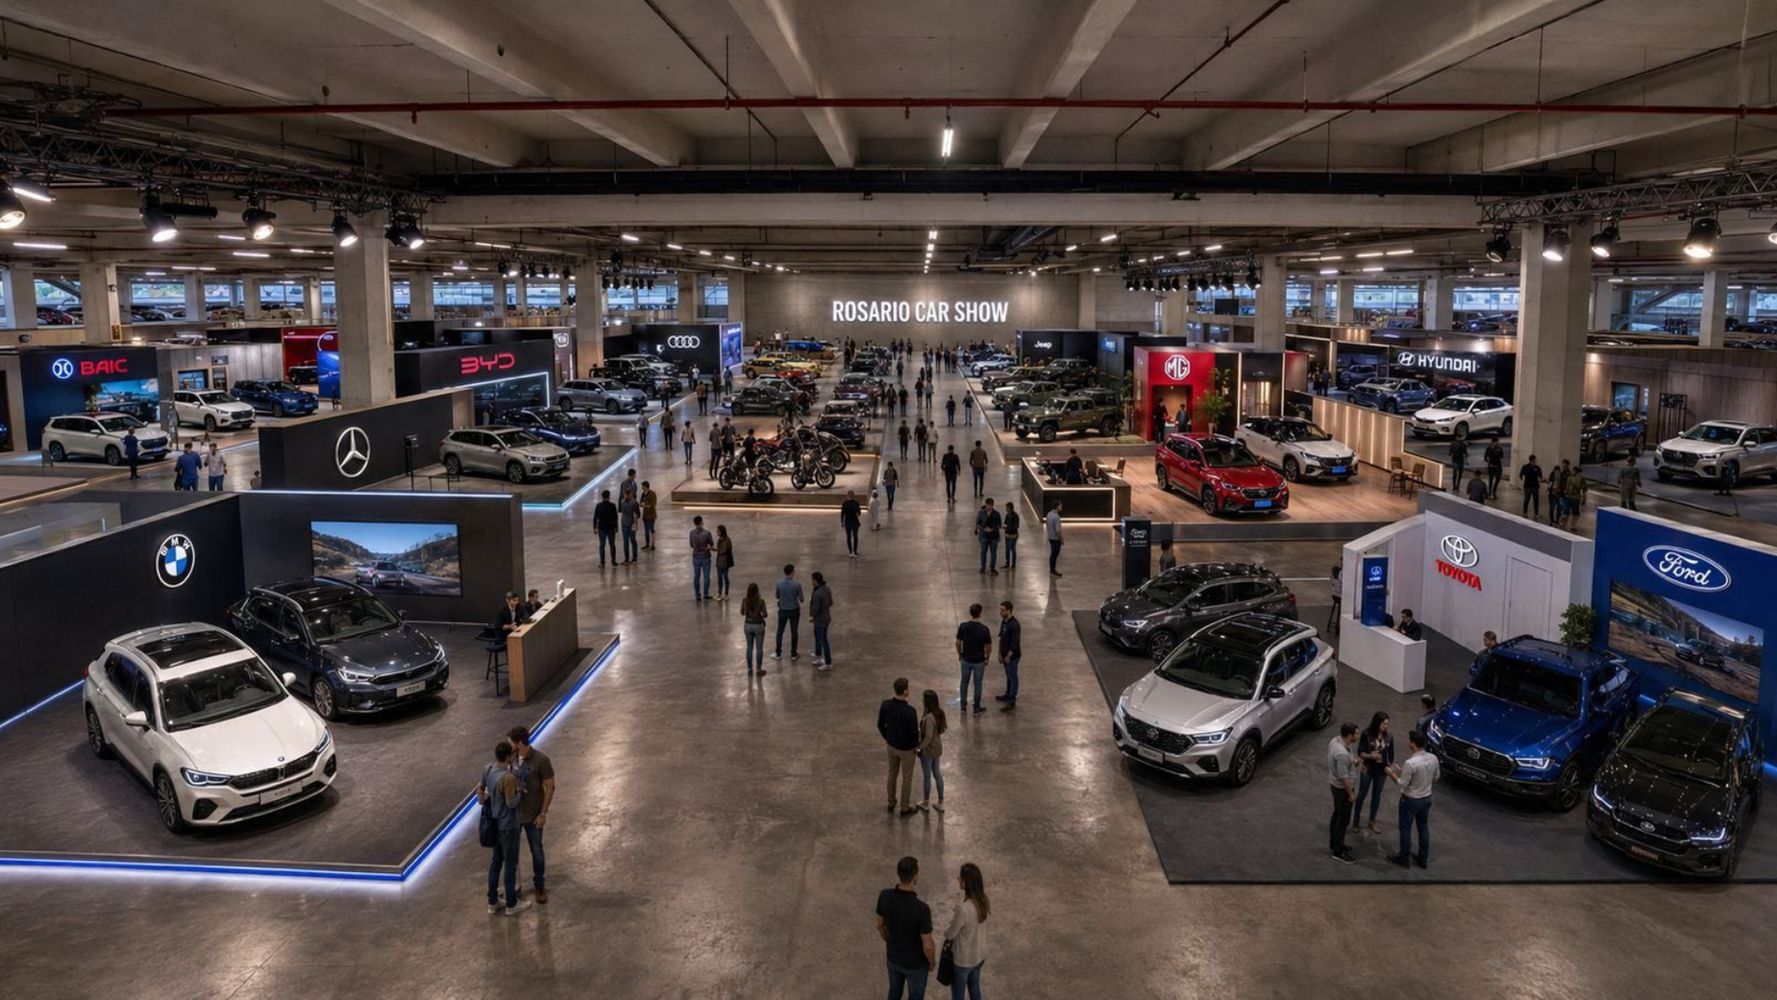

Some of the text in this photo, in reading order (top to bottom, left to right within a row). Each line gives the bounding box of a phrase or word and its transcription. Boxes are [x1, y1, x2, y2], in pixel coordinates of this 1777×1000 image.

[832, 300, 1009, 323] ROSARIO CAR SHOW
[1034, 340, 1052, 350] Jeep
[80, 359, 128, 375] BAIC
[460, 353, 515, 375] BYD
[1165, 355, 1190, 380] MG
[1417, 354, 1477, 374] HYUNDAI
[1435, 559, 1482, 592] TOYOTA
[1659, 551, 1712, 585] Ford
